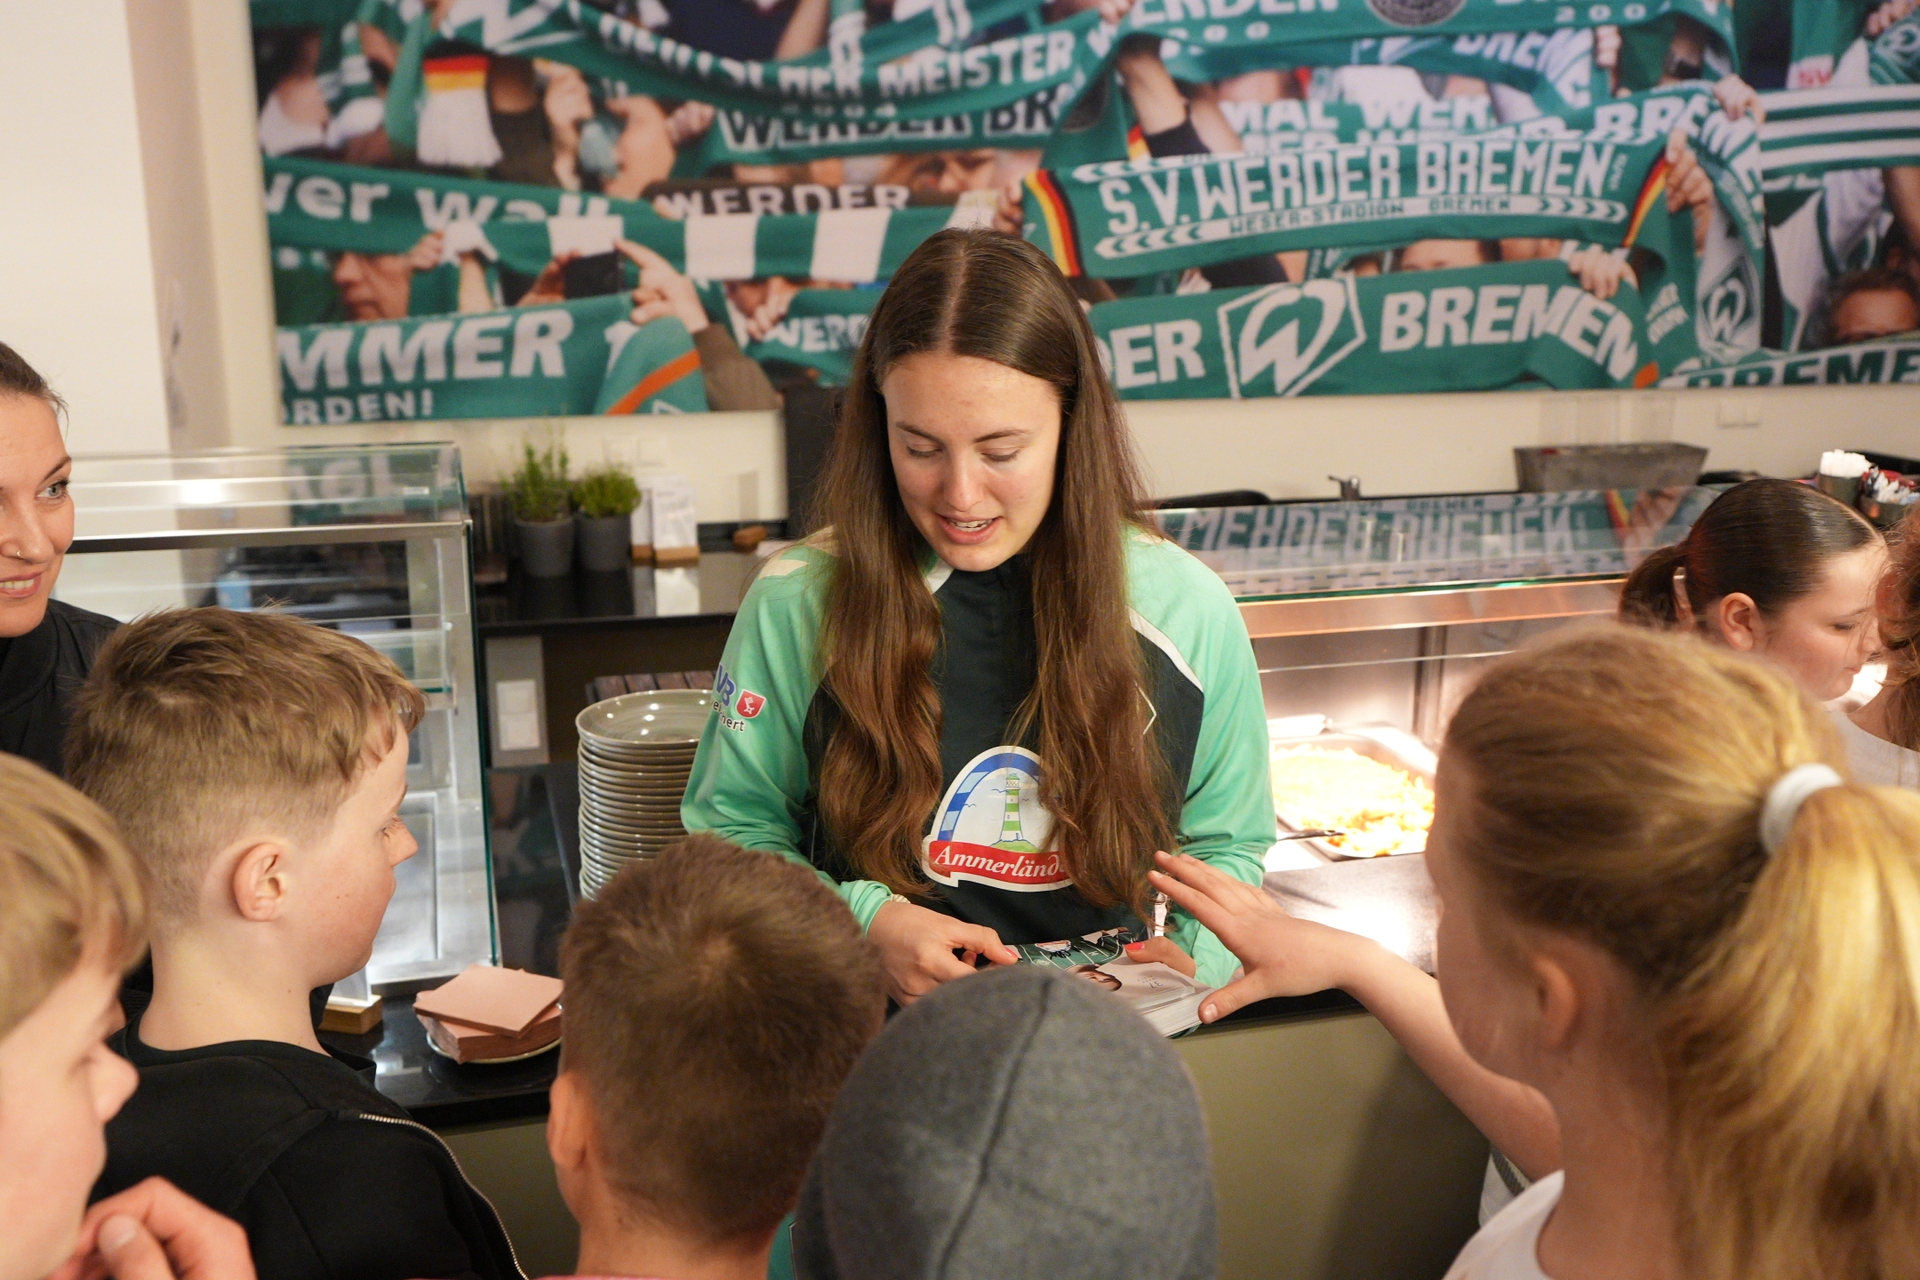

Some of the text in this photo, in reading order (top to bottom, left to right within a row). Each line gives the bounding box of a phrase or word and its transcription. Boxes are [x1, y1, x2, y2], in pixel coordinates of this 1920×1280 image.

[878, 29, 1077, 98] MEISTER
[1416, 132, 1616, 198] BREMEN
[1380, 284, 1639, 381] BREMEN
